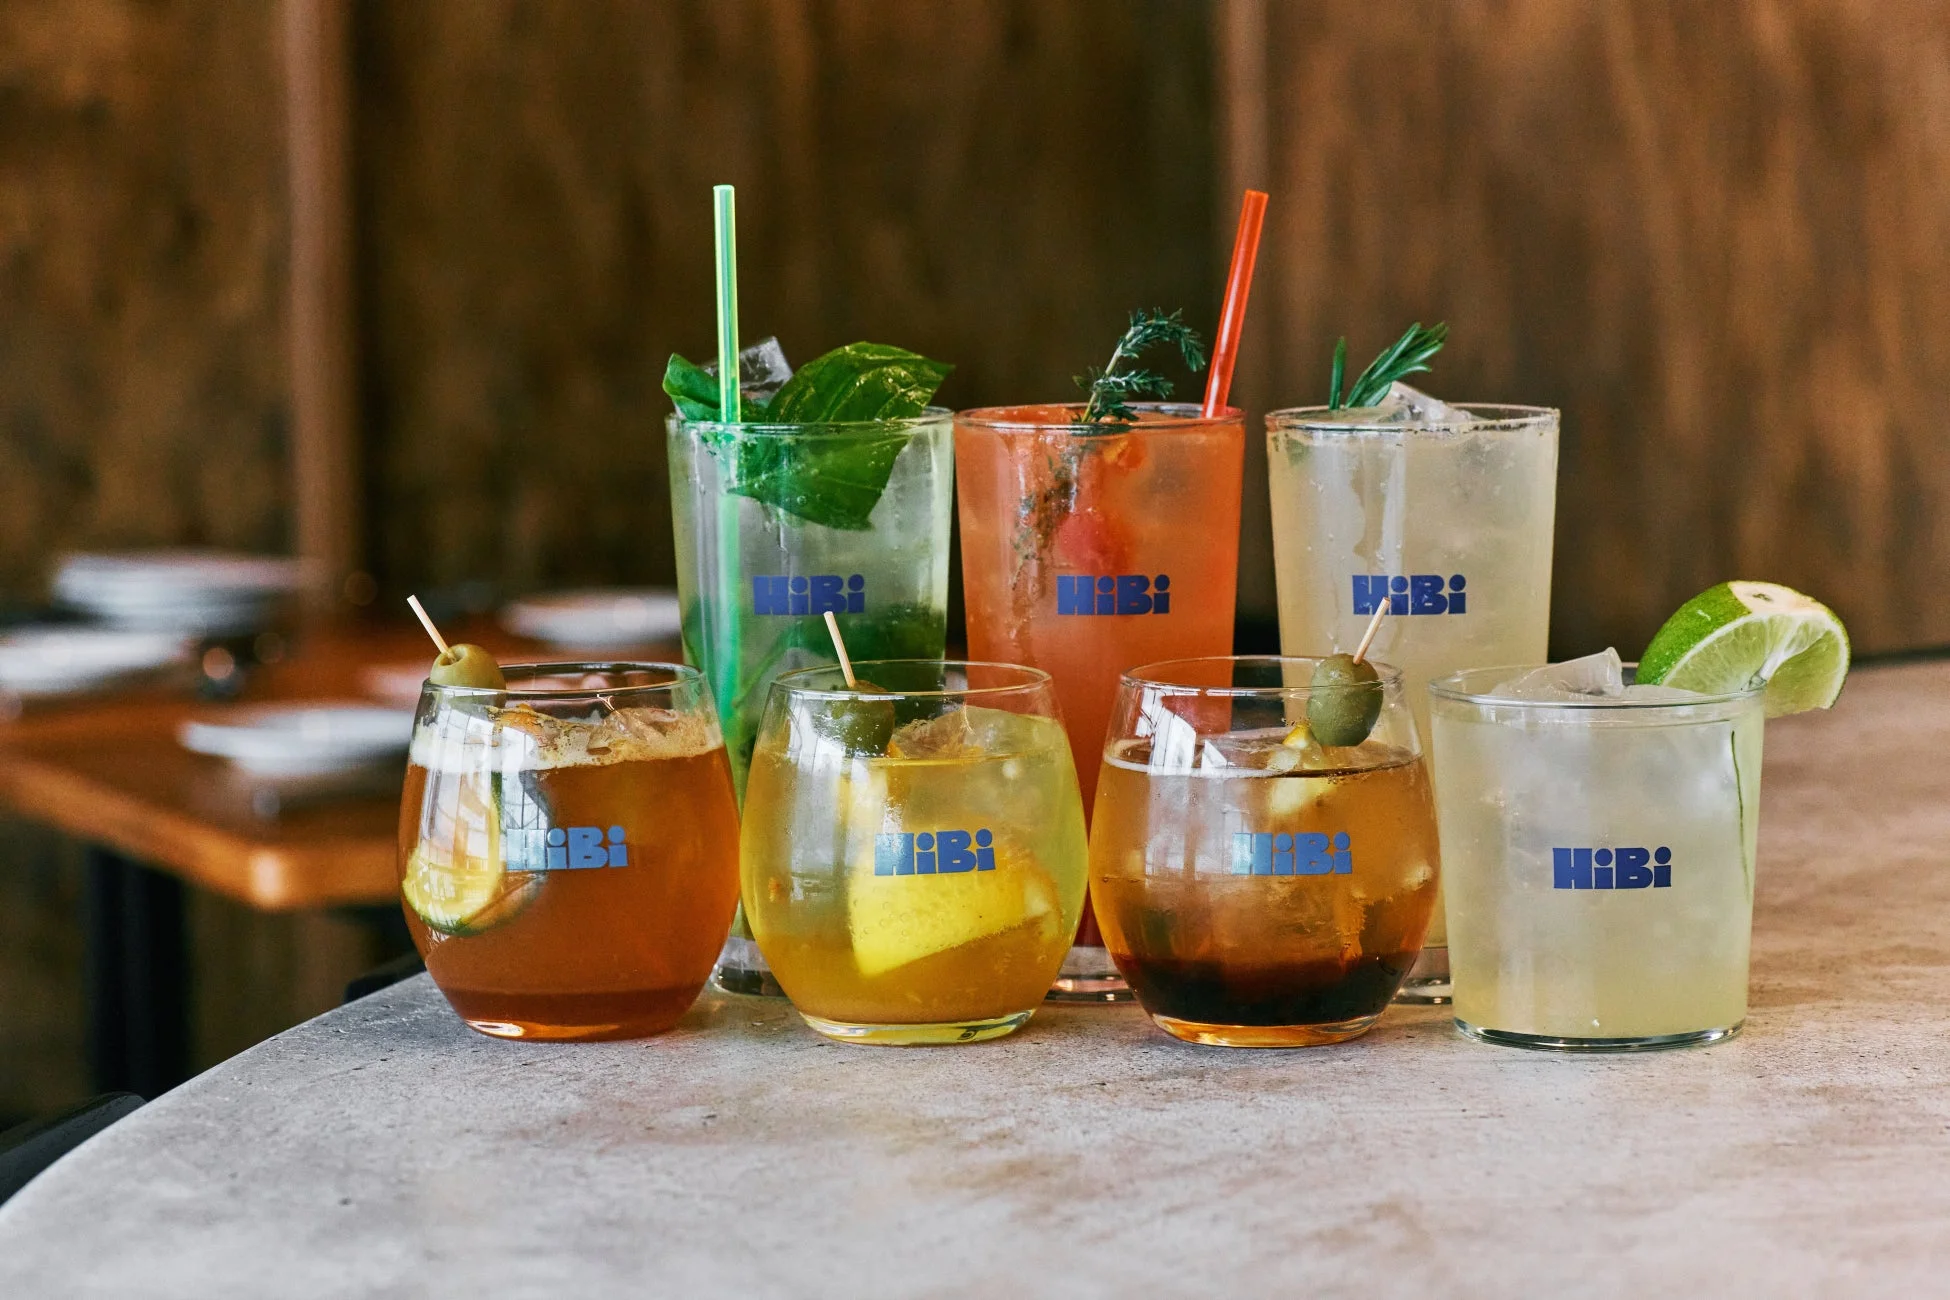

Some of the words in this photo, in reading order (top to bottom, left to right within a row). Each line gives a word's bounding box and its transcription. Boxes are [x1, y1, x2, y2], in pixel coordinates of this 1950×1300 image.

[753, 574, 865, 615] HiBi
[1057, 574, 1170, 615] HiBi
[1352, 574, 1466, 615] HiBi
[506, 826, 628, 870] HiBi
[874, 828, 996, 876] HiBi
[1232, 832, 1352, 875] HiBi
[1552, 847, 1671, 889] HiBi
